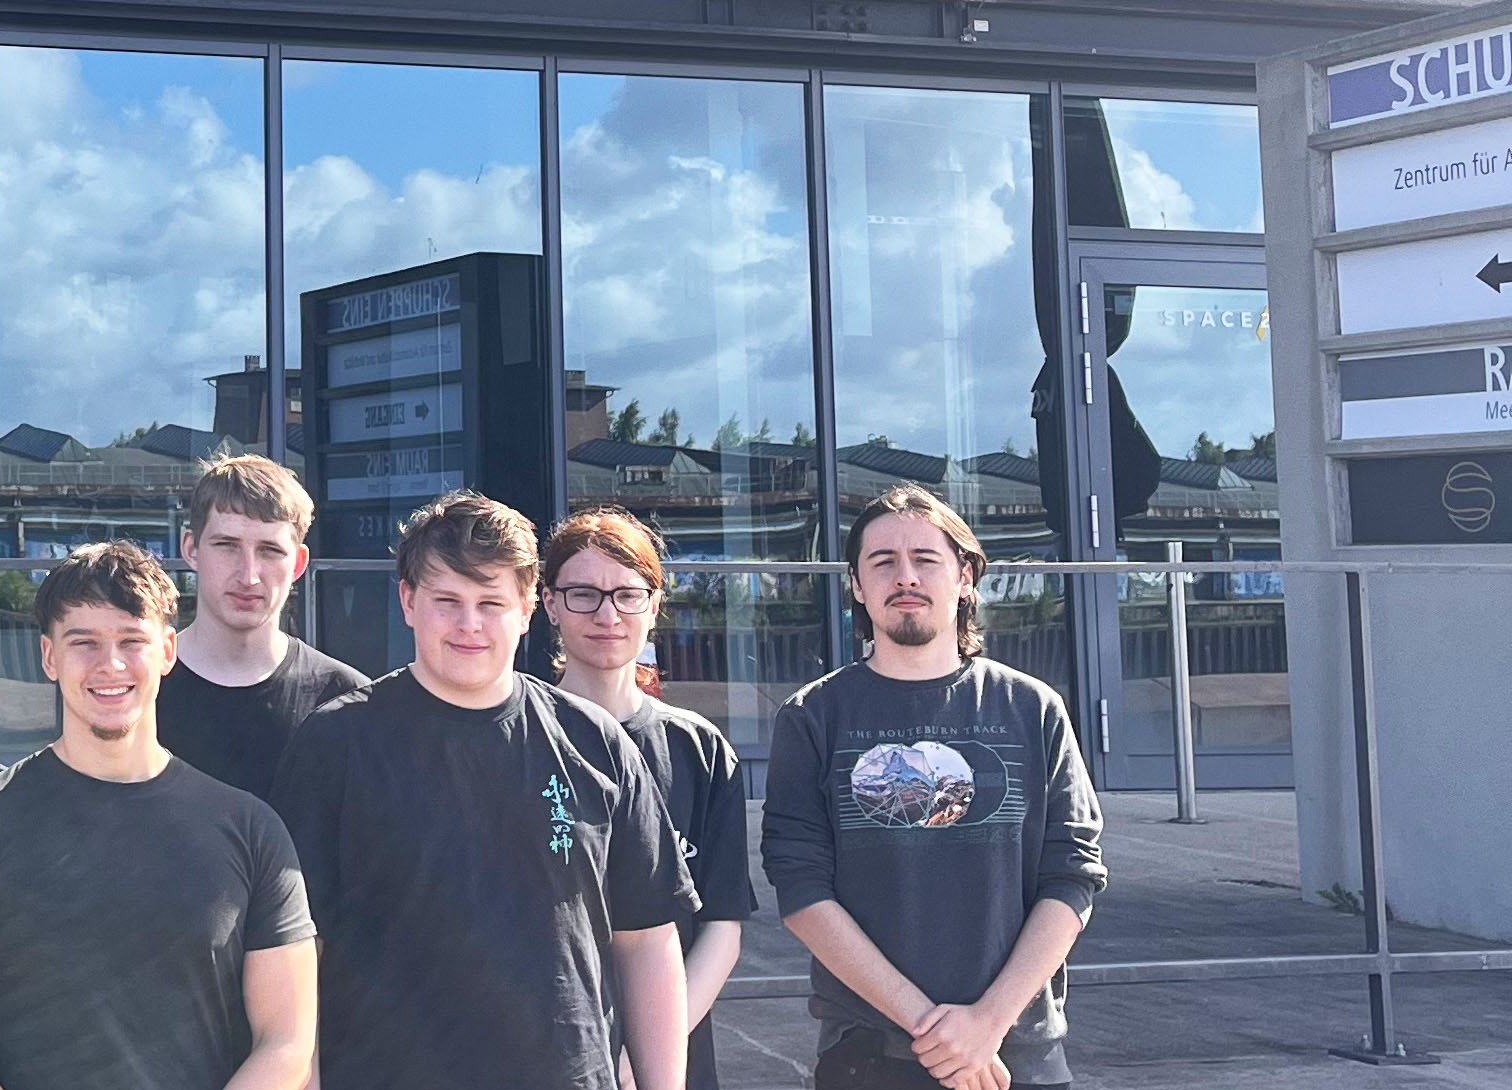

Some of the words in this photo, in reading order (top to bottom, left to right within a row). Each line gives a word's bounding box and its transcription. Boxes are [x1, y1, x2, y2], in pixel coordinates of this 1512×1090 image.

[1389, 32, 1512, 111] SCHU
[1393, 160, 1467, 190] Zentrum
[1472, 151, 1498, 177] für
[1483, 346, 1512, 392] R
[847, 730, 873, 740] THE
[878, 725, 959, 738] ROUTEBURN
[963, 724, 1008, 736] TRACK
